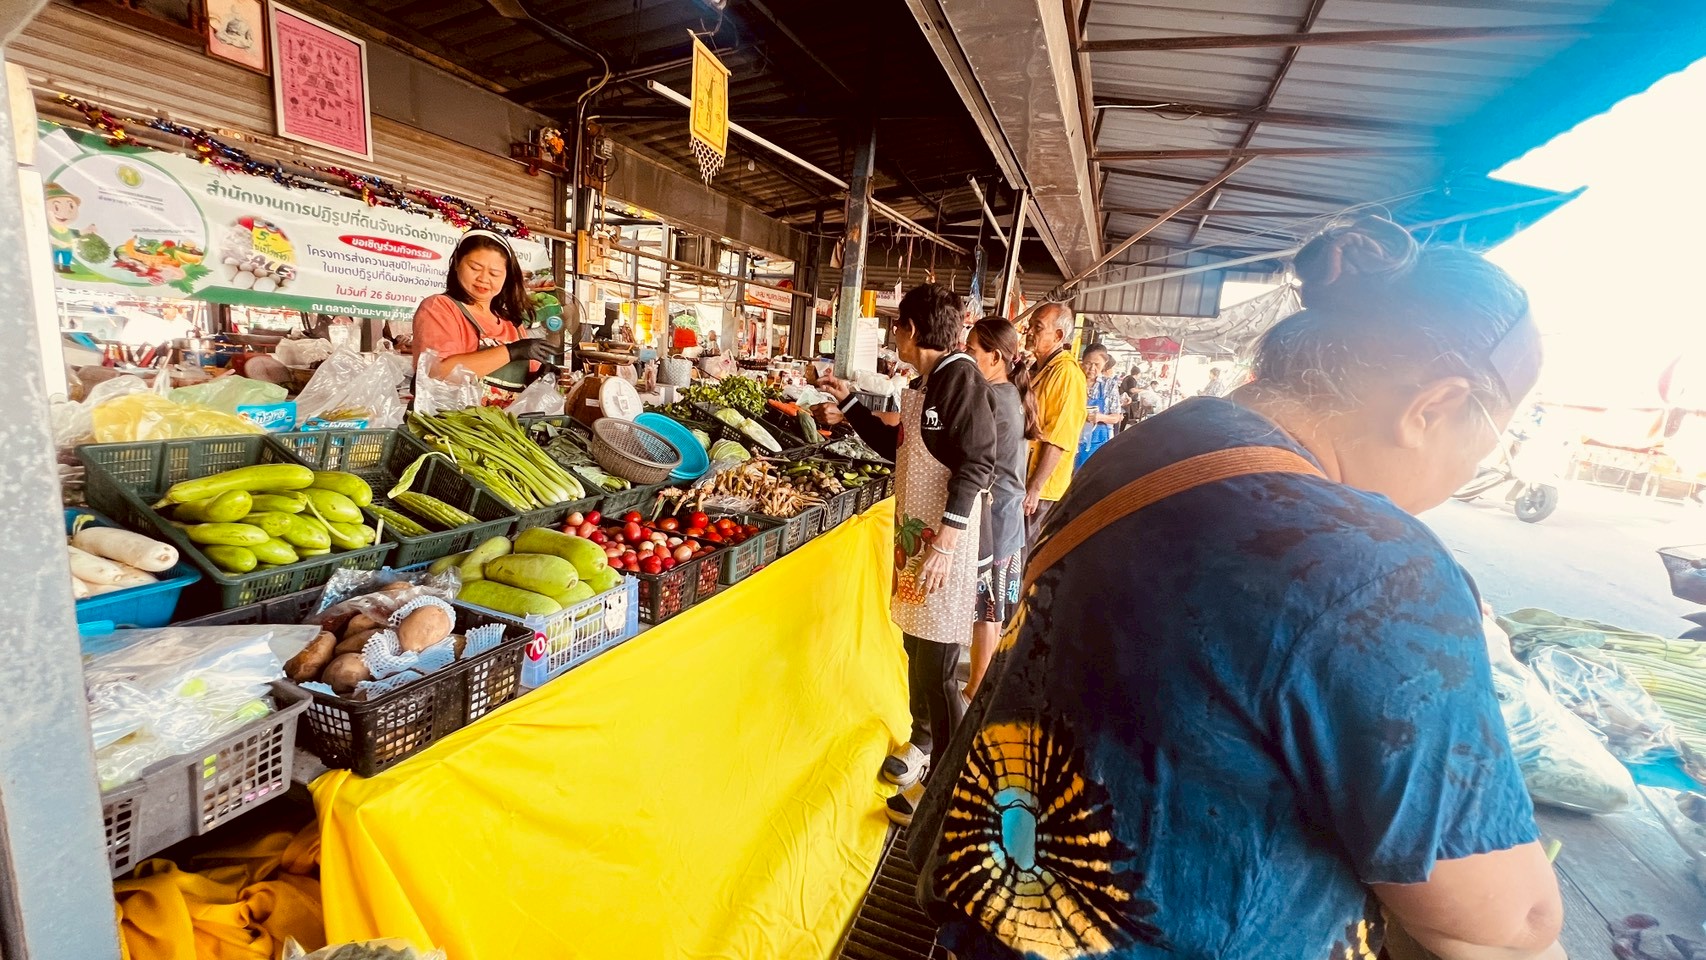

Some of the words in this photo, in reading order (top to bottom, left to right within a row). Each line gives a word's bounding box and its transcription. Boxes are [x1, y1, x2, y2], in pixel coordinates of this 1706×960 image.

[352, 237, 432, 259] ขอเชิญร่วมกิจกรรม
[336, 284, 367, 298] ในวันที่
[370, 290, 382, 299] 26
[385, 291, 416, 303] ธันวาคม
[312, 303, 322, 311] ณ
